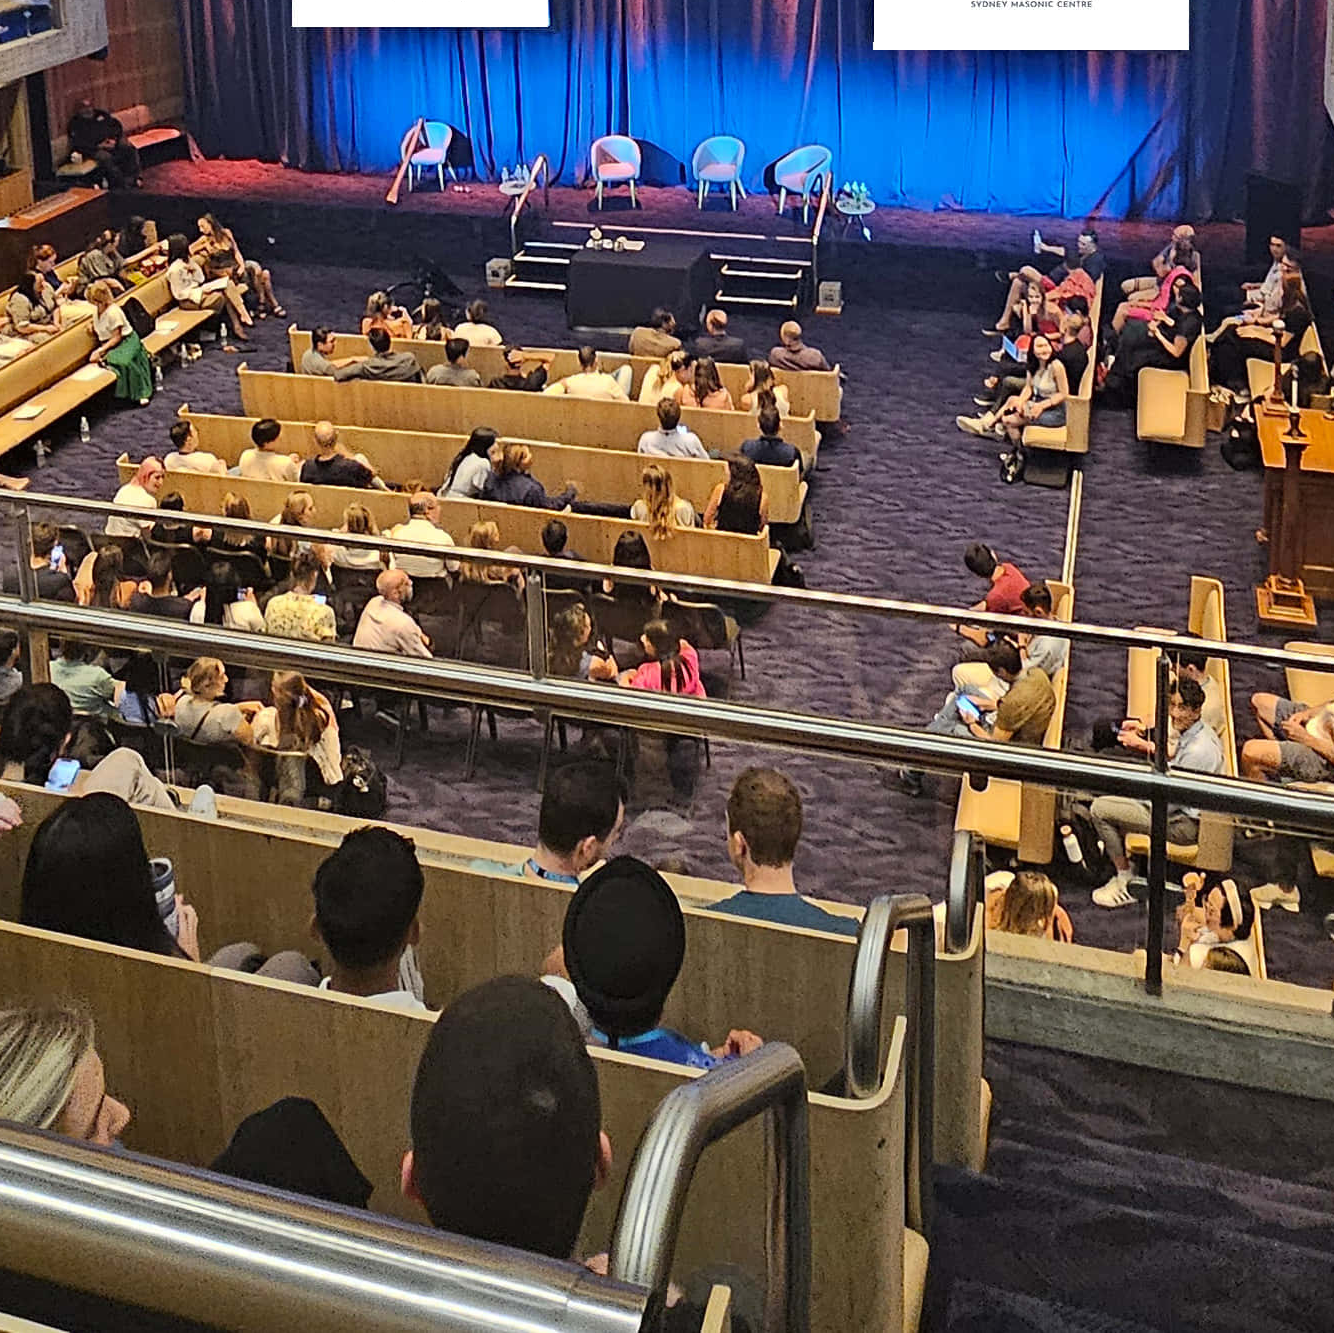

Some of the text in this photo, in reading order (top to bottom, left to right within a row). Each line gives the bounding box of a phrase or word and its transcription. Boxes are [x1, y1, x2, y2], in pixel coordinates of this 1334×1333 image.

[970, 0, 1093, 8] SYDNEY MASONIC CENTRE
